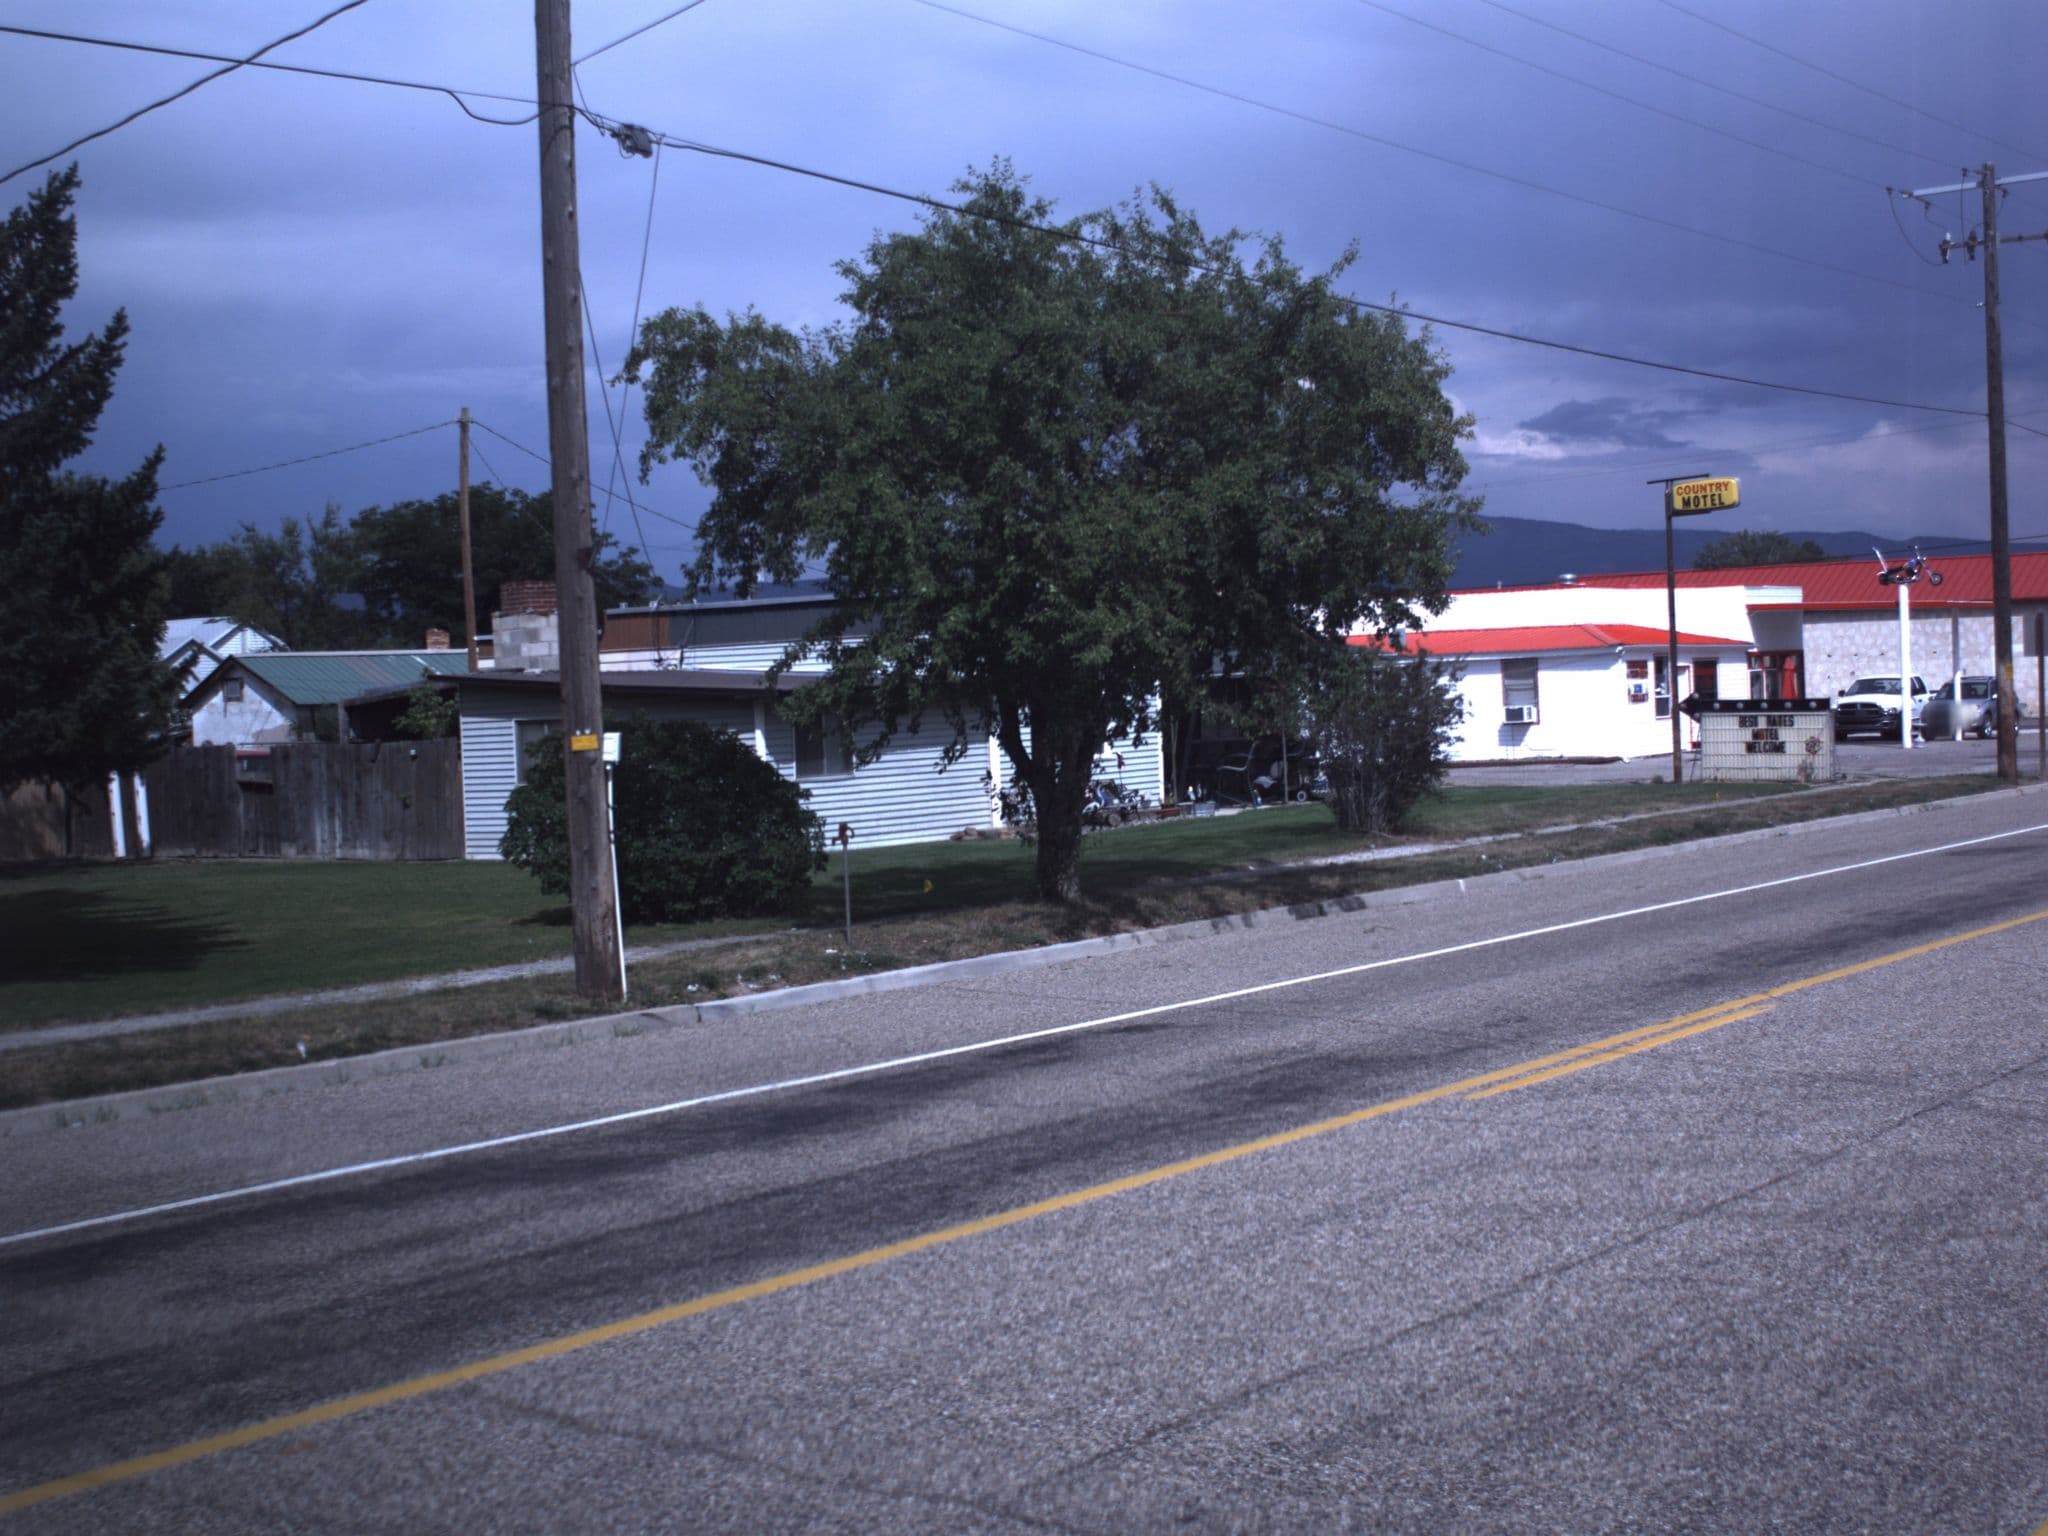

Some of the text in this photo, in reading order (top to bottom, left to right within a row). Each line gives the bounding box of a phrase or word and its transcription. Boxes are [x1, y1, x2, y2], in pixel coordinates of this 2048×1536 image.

[1676, 481, 1729, 496] COUNTRY
[1682, 494, 1724, 508] MOTEL
[1739, 715, 1758, 727] BEST
[1752, 728, 1778, 740] MOTEL
[1745, 741, 1786, 753] WELCOME
